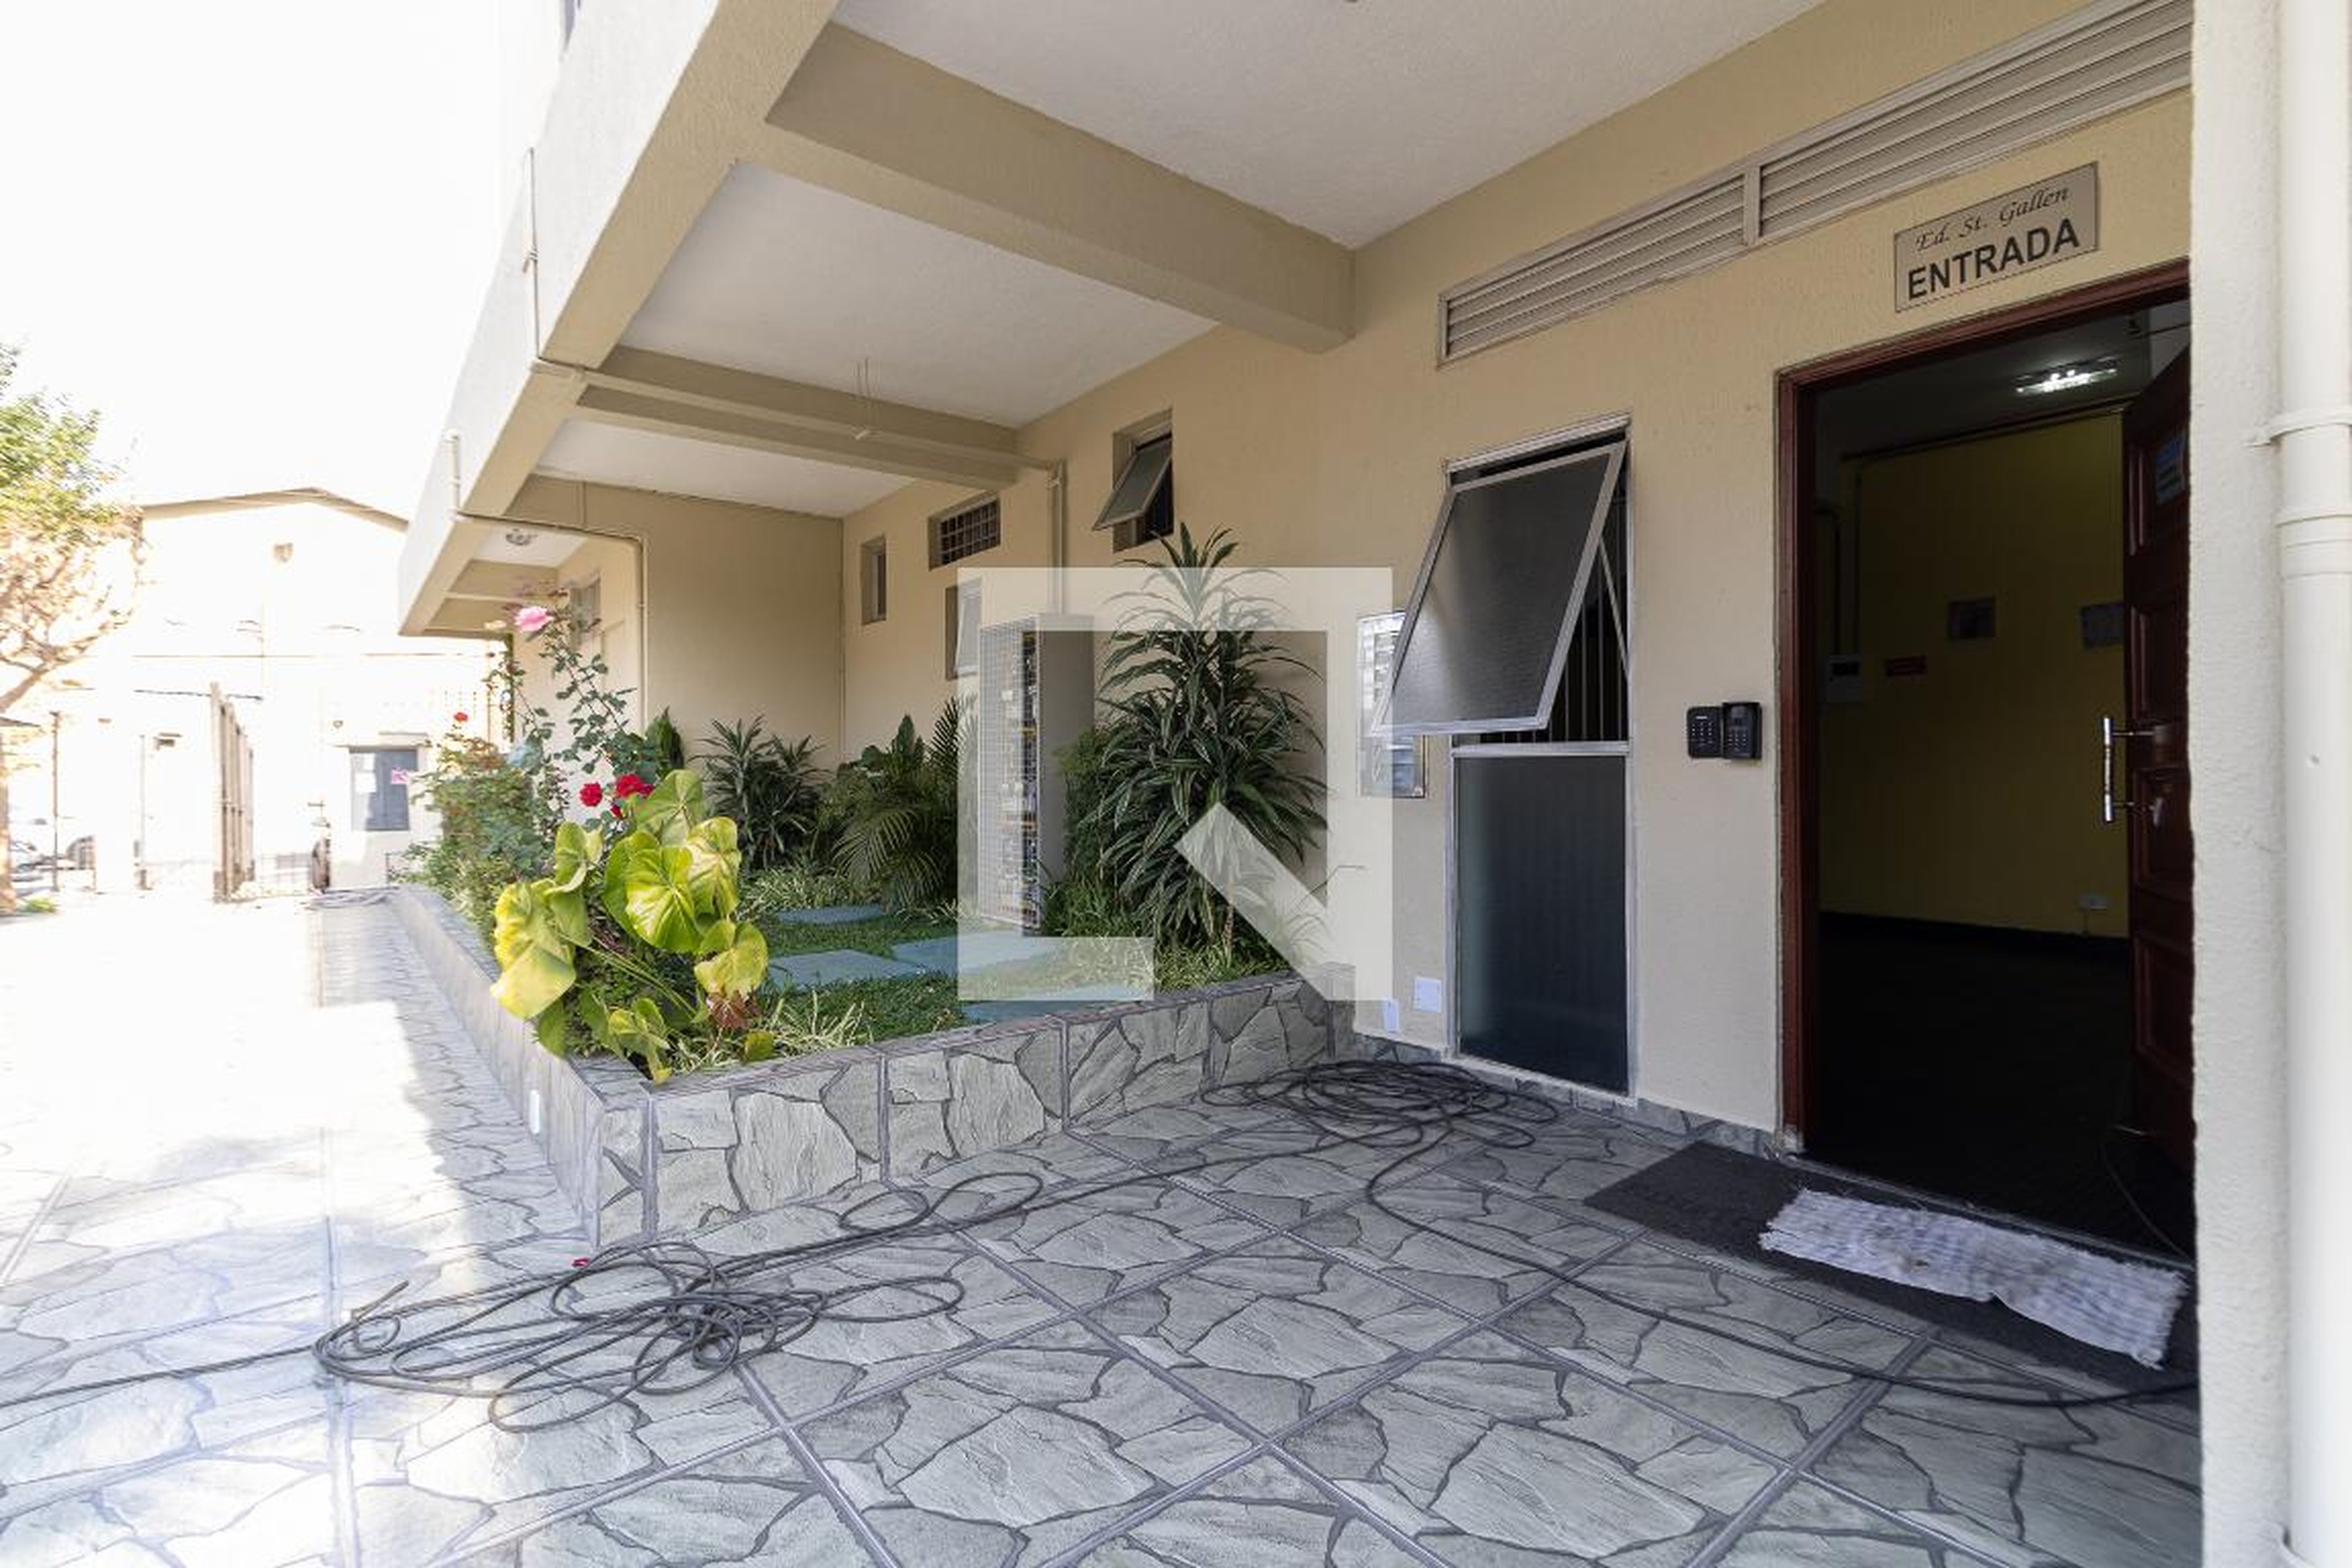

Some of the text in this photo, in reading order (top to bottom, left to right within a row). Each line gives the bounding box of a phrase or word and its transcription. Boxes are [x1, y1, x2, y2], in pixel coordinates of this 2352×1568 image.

[1915, 187, 2069, 252] Ed. St. Gallen
[1909, 217, 2080, 300] ENTRADA
